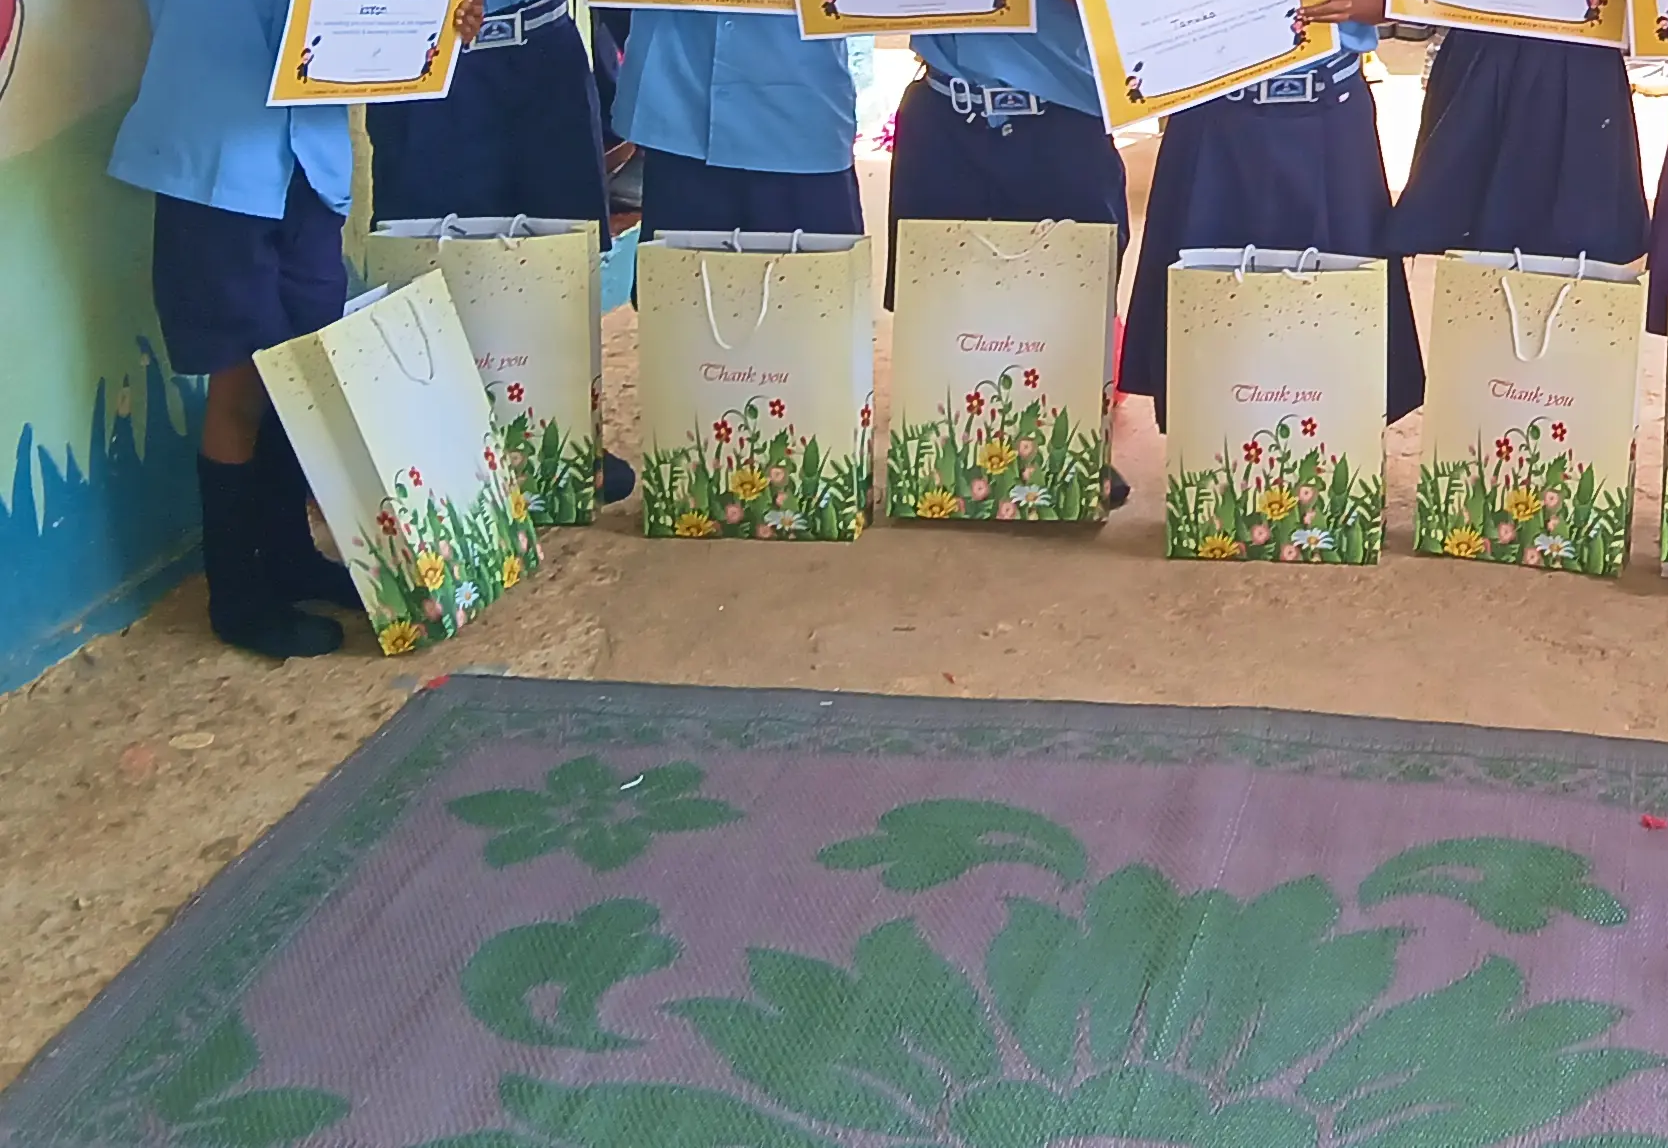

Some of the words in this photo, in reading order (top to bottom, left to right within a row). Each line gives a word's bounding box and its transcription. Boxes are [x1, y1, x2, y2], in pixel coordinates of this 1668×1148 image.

[956, 333, 1014, 352] Thank
[1015, 341, 1046, 355] you
[497, 353, 528, 371] you
[699, 363, 756, 383] Thank
[759, 371, 789, 386] you
[1231, 384, 1290, 402] Thank
[1292, 391, 1322, 404] you
[1488, 379, 1544, 403] Thank
[1544, 394, 1574, 406] you
